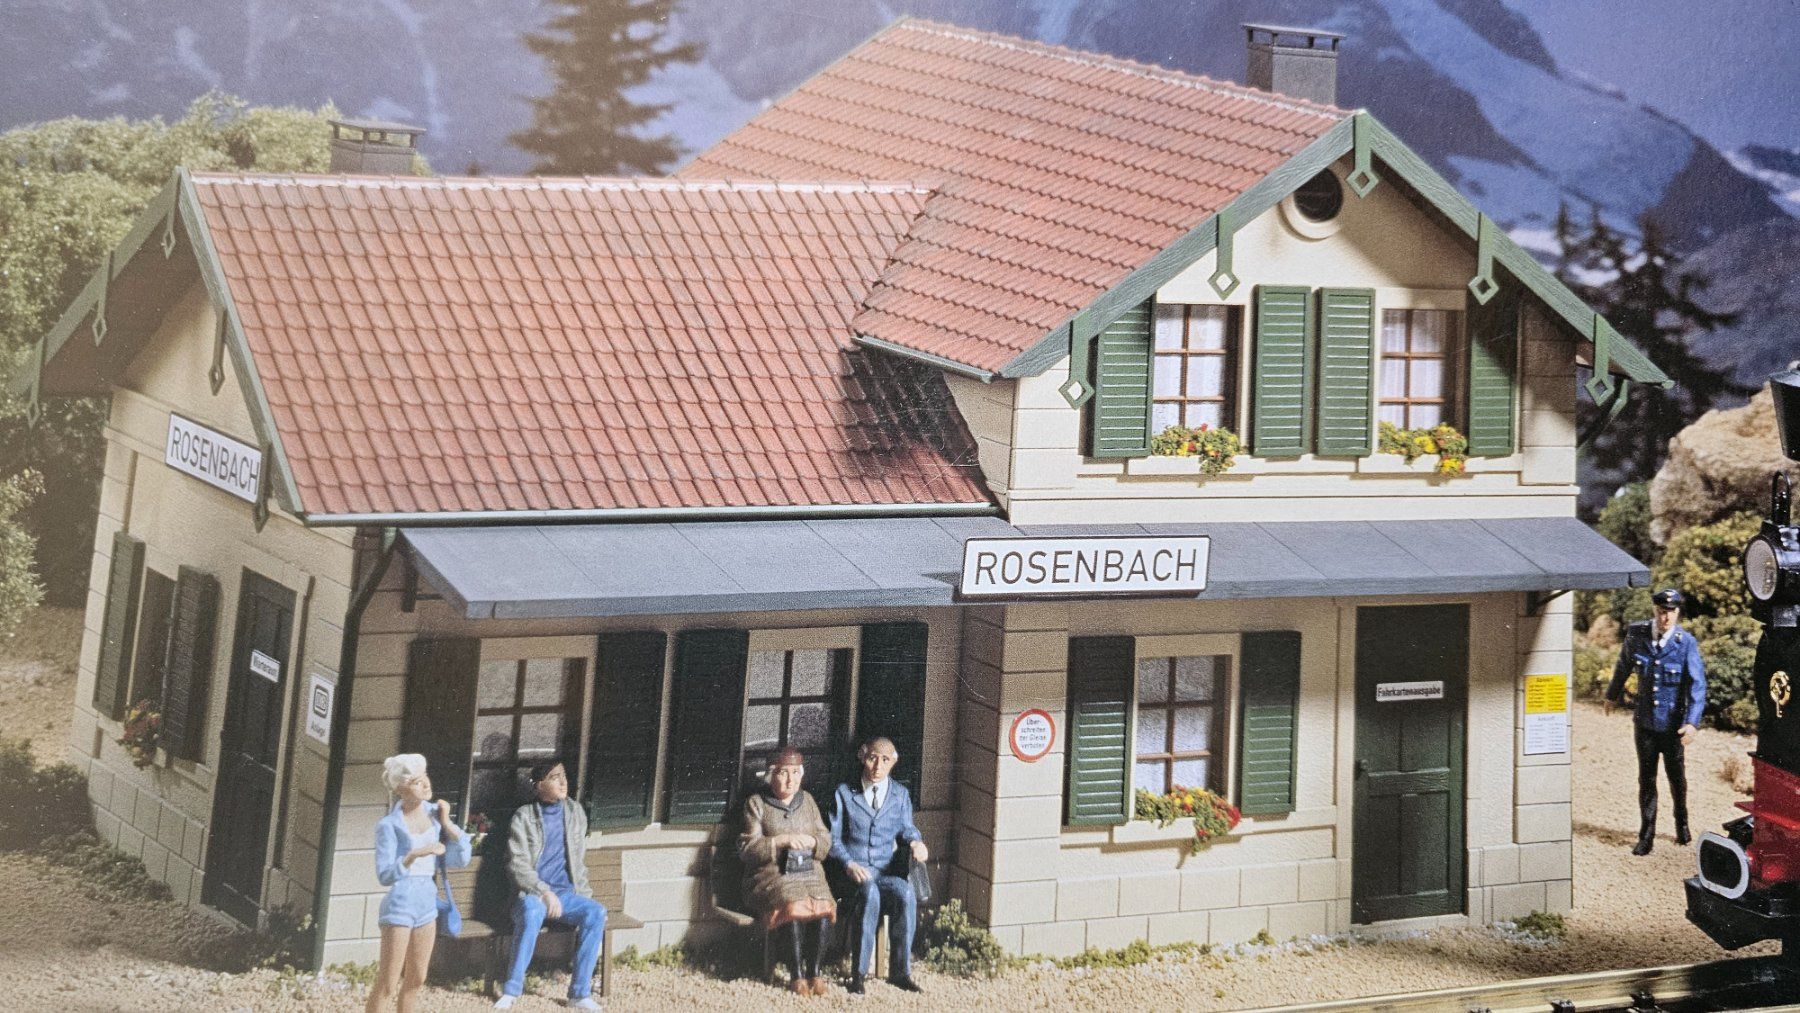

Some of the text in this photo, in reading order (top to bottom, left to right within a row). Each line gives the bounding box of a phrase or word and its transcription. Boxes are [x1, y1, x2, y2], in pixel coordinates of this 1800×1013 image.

[170, 426, 259, 495] ROSENBACH
[974, 548, 1197, 585] ROSENBACH
[1377, 684, 1441, 697] Fahrkartenausgabe
